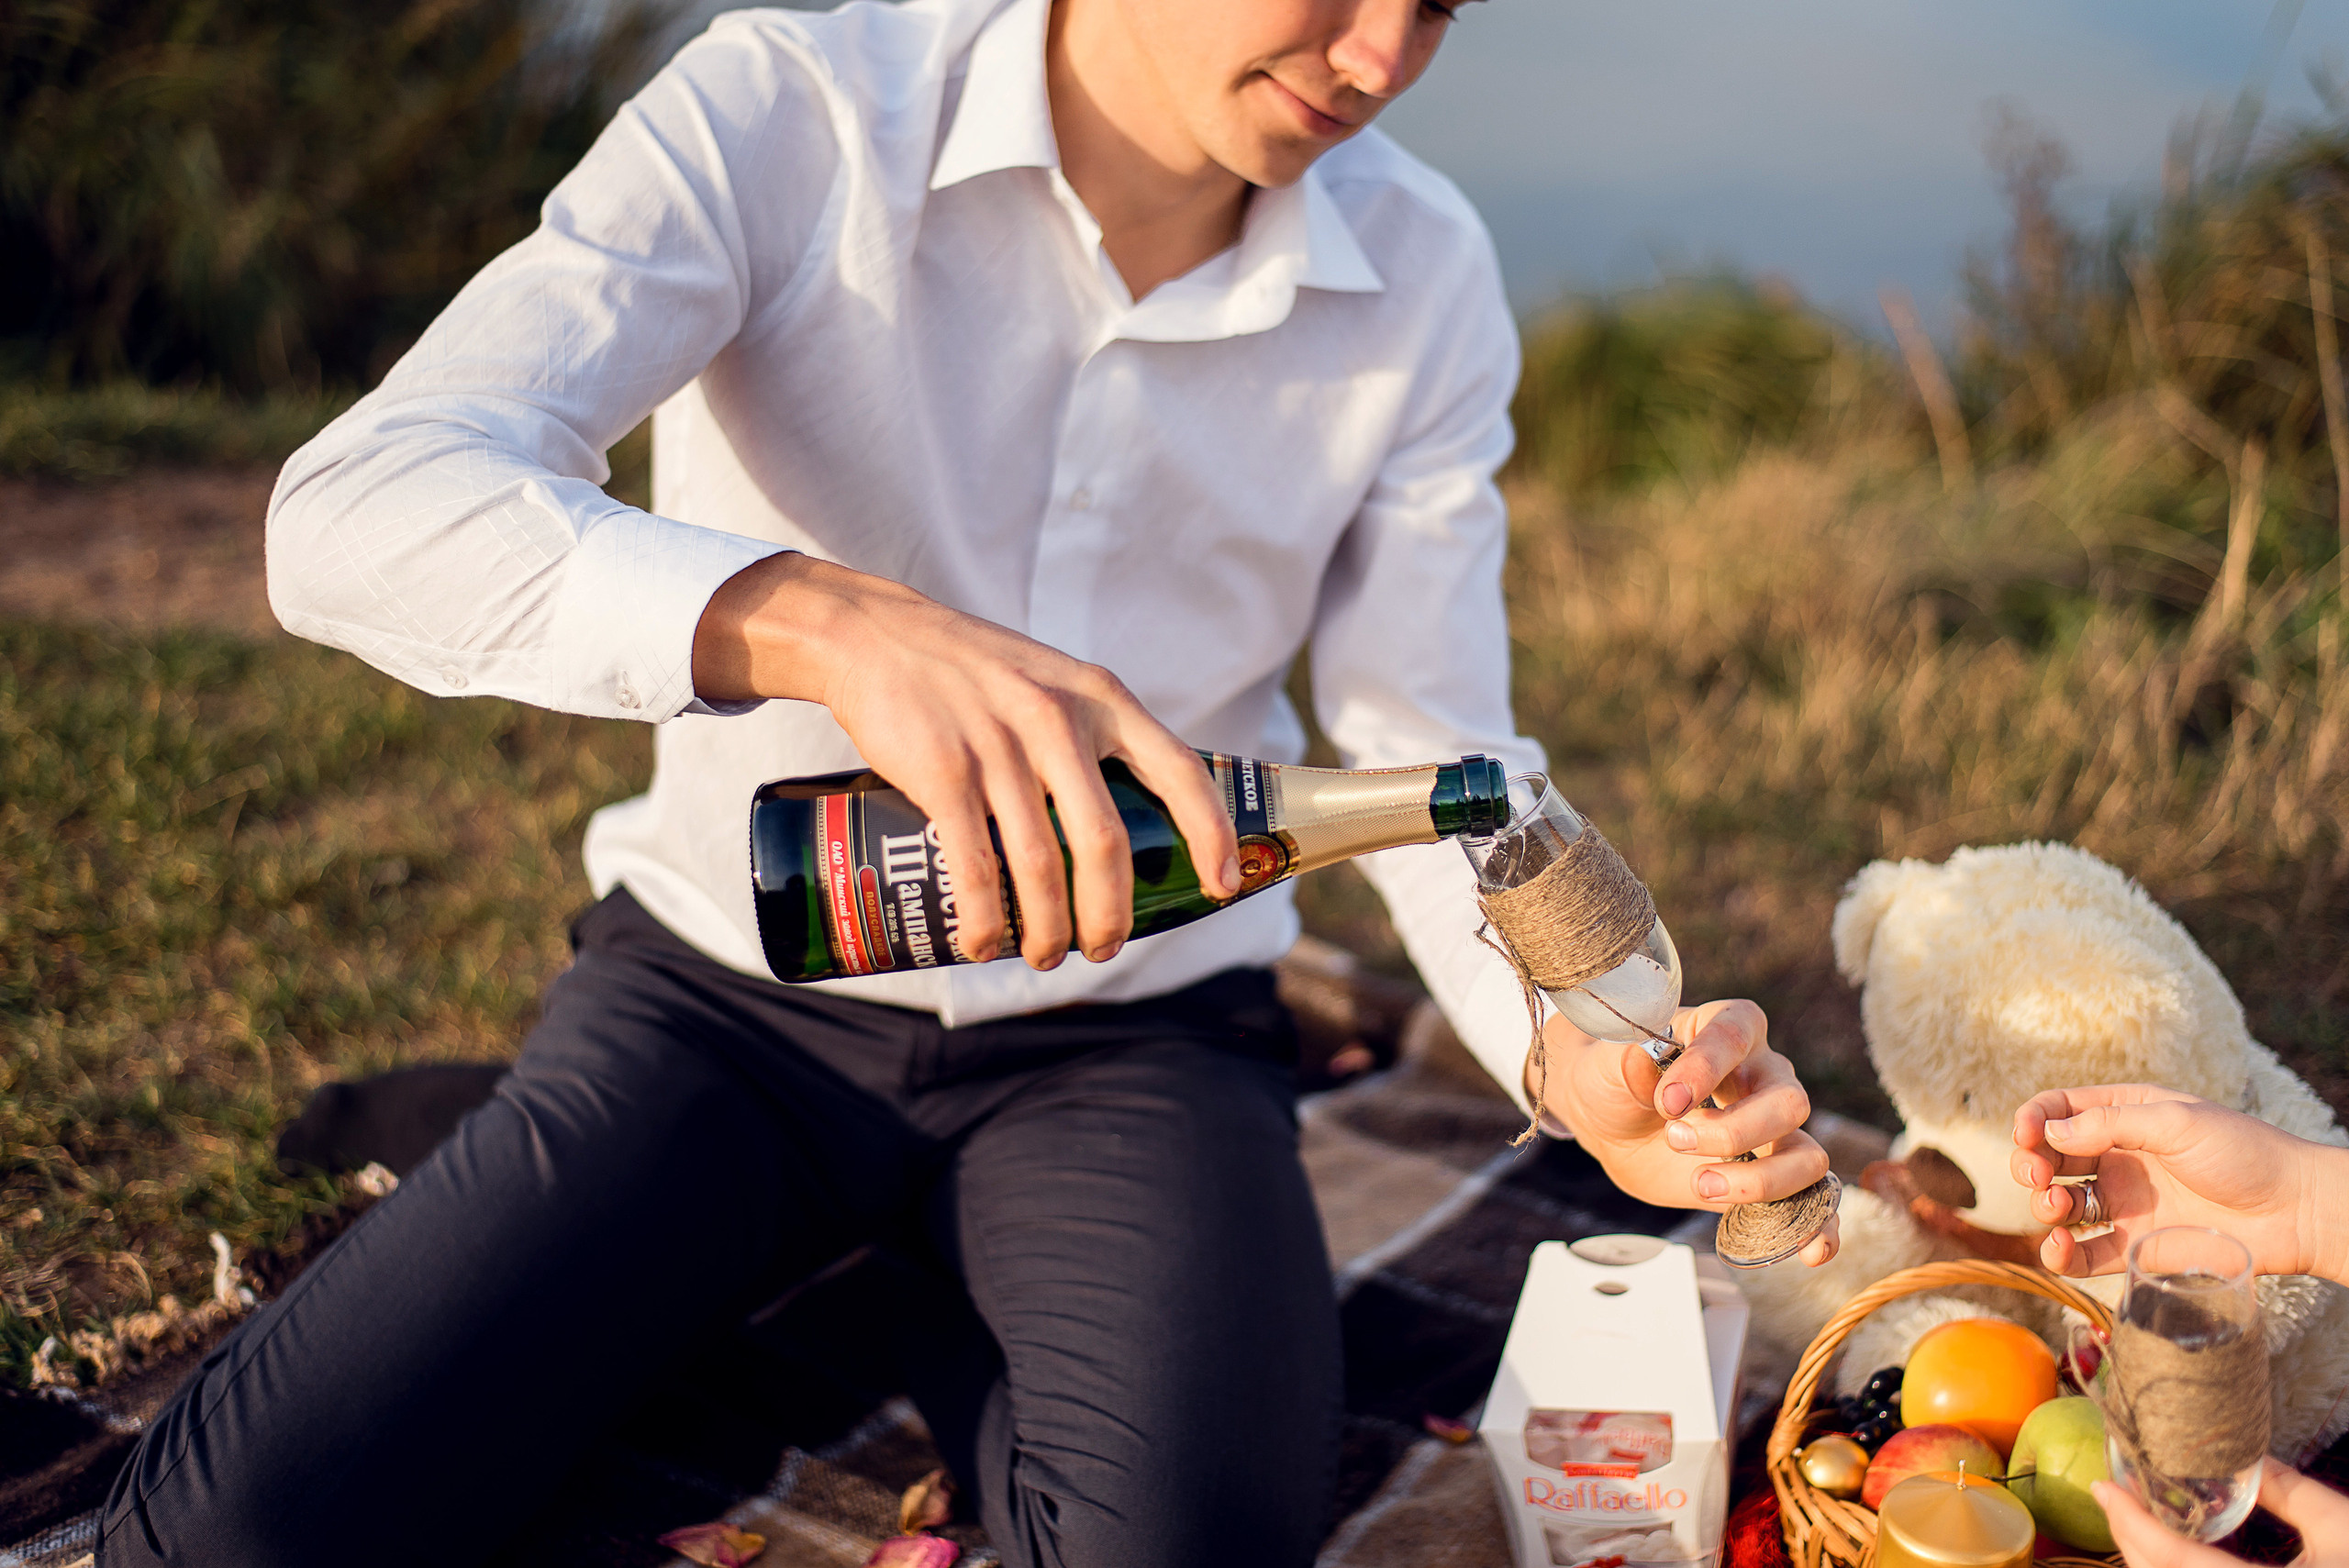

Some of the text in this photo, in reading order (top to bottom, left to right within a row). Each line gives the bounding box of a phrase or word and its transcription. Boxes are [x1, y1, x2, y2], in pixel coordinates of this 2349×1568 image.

[832, 840, 844, 864] ОАО
[841, 919, 856, 943] завод
[866, 891, 885, 957] ПОЛУСЛАДКОЕ
[1524, 1477, 1687, 1514] Raffaello
